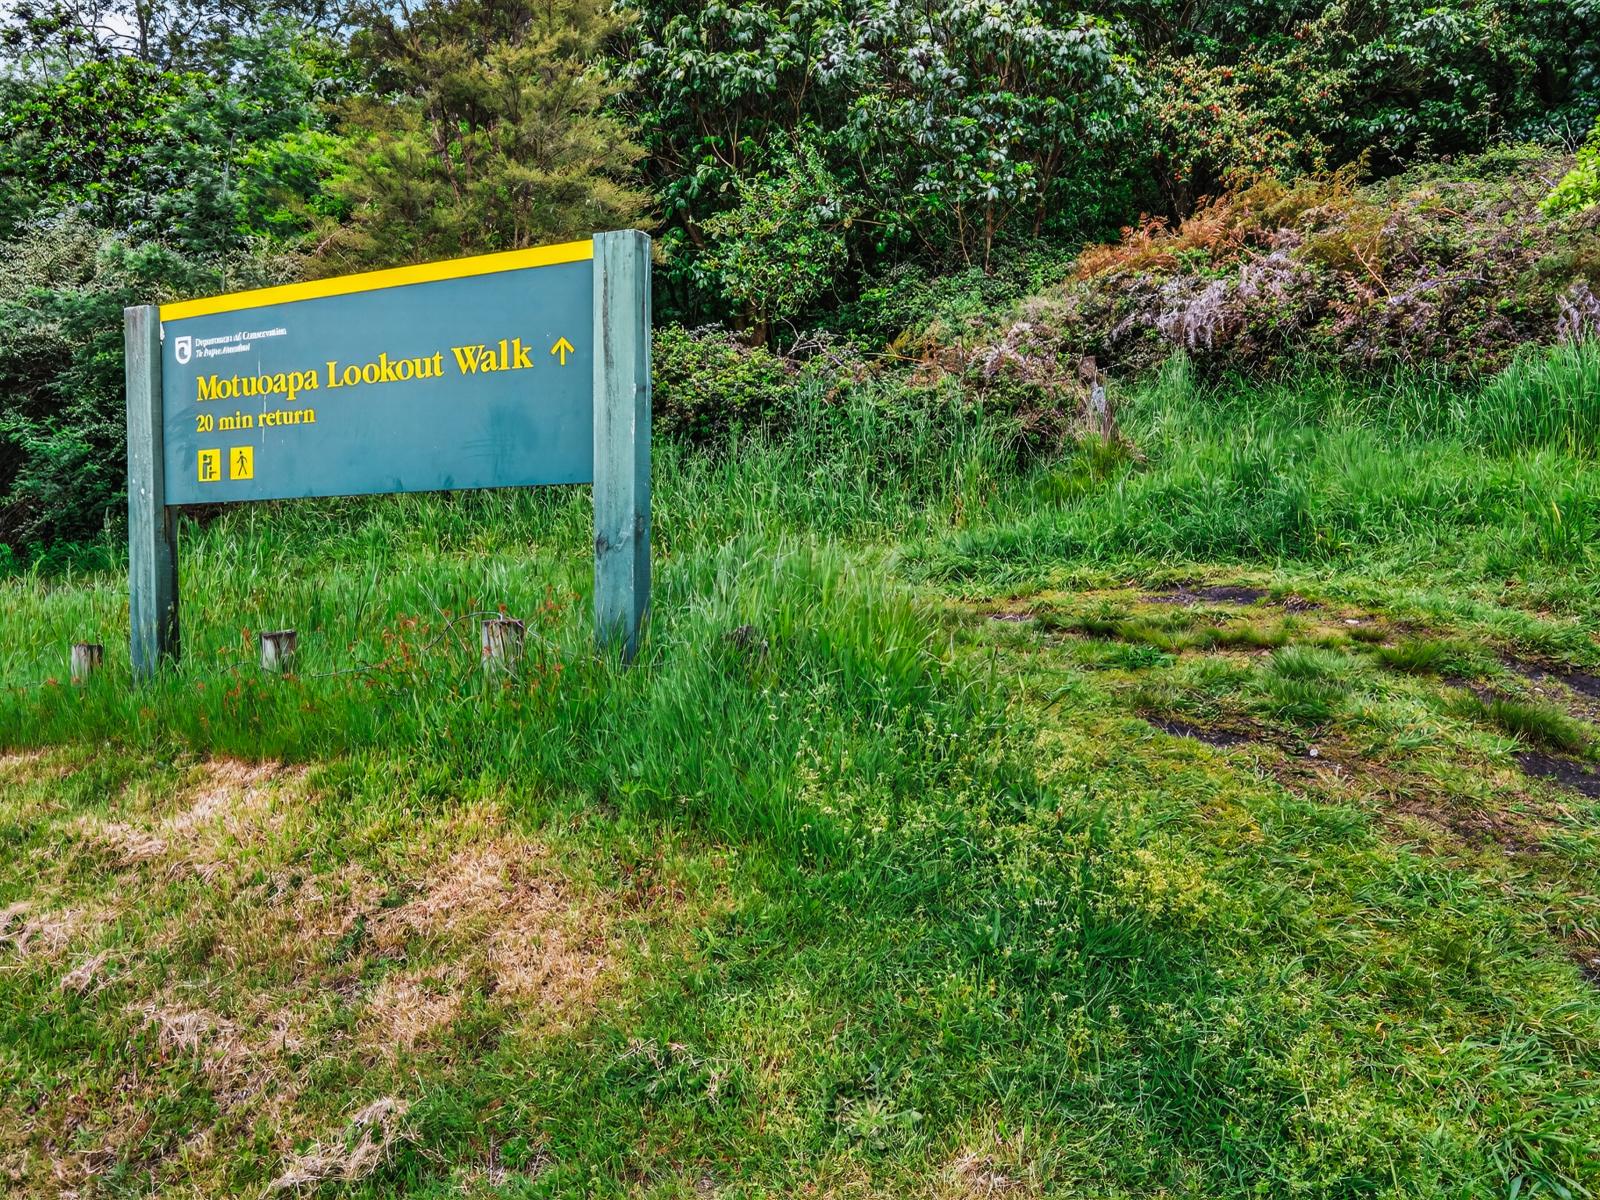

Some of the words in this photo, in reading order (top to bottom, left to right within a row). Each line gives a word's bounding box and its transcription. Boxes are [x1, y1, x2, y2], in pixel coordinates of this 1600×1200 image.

[196, 370, 318, 401] Motuoapa
[327, 352, 443, 387] Lookout
[452, 338, 533, 374] Walk
[196, 415, 214, 432] 20
[218, 411, 253, 431] min
[258, 409, 315, 426] return
